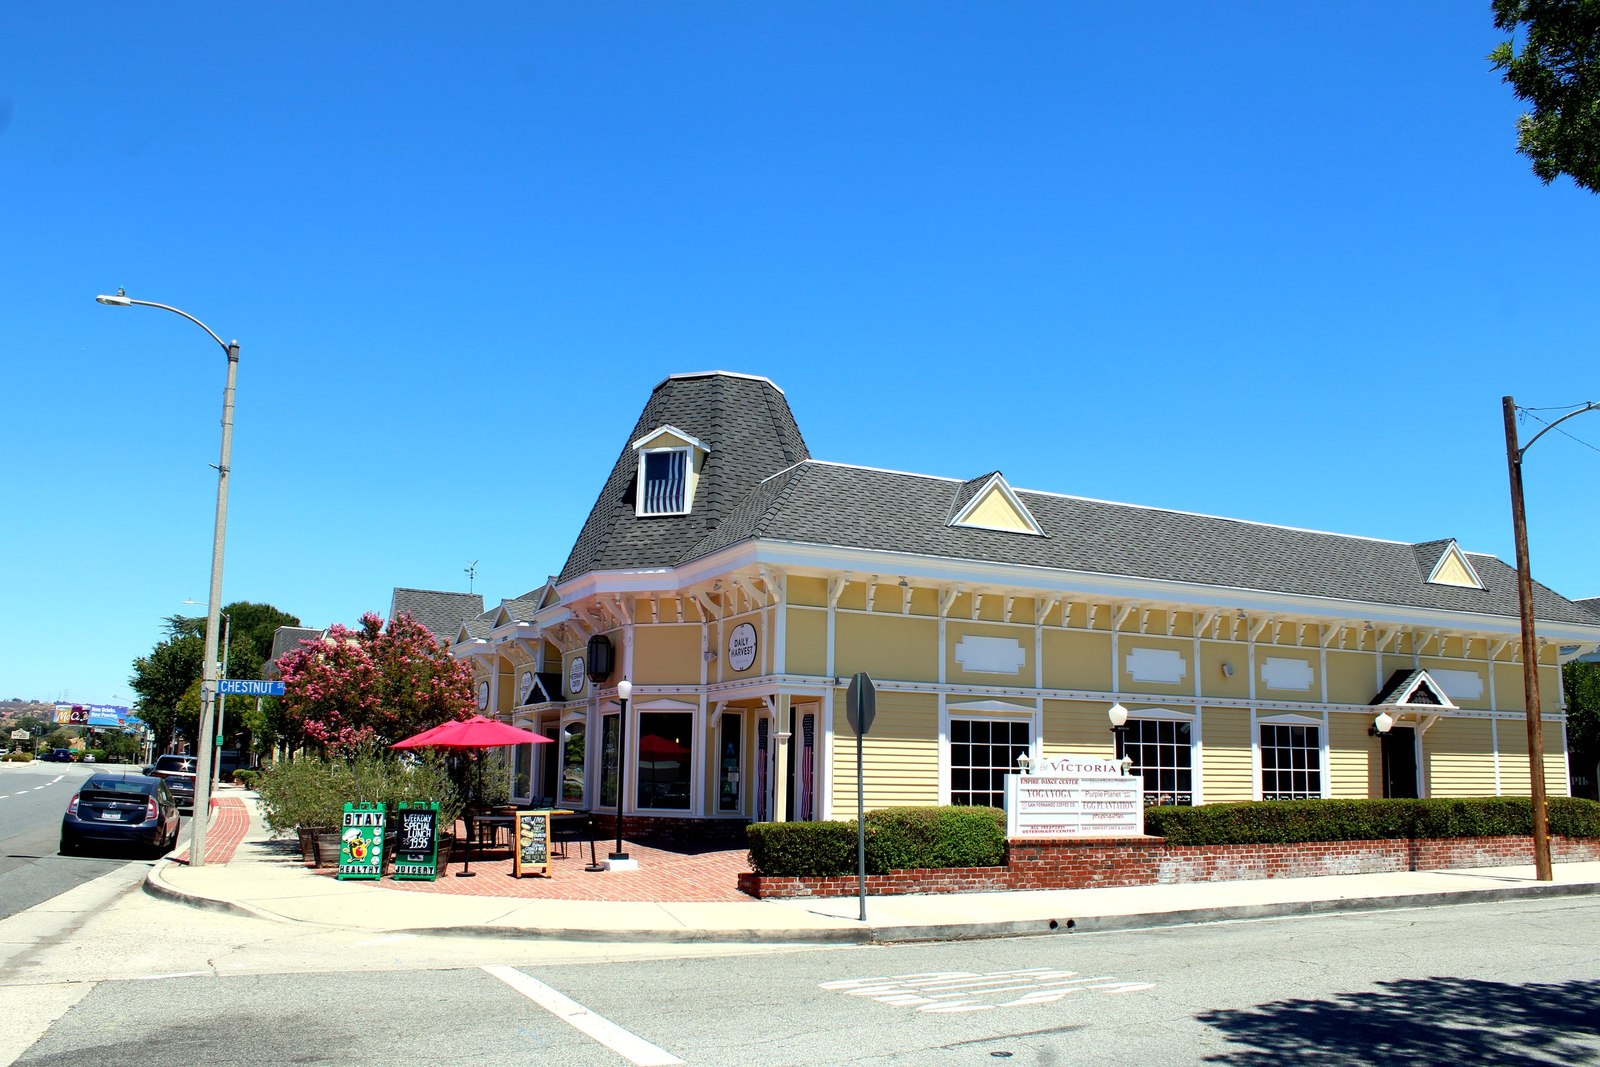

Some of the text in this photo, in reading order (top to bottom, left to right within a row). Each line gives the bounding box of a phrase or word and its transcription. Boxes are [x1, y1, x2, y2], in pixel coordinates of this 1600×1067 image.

[734, 637, 749, 648] DAILY
[731, 646, 753, 658] HARVEST
[220, 680, 273, 693] CHESTNUT
[1051, 759, 1116, 773] VICTORIA
[345, 813, 382, 825] STAY
[403, 813, 432, 822] WEEKDAY
[403, 822, 432, 831] SPECIAL
[407, 829, 432, 838] LUNCH
[340, 865, 379, 873] HEALTHY
[396, 865, 434, 874] JUICERY
